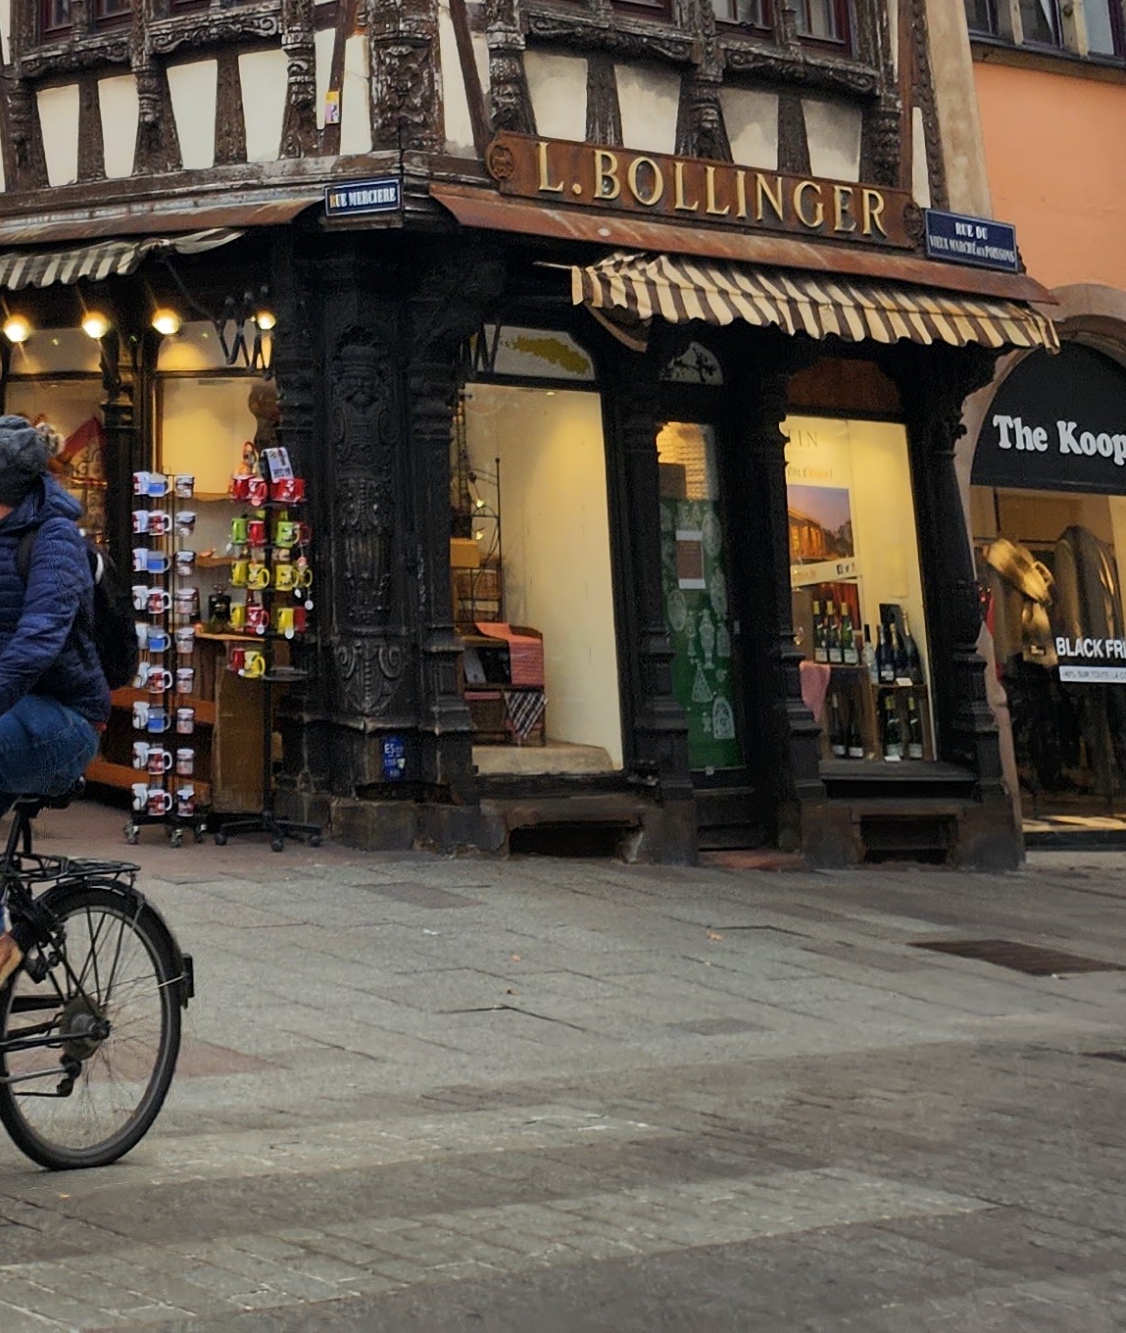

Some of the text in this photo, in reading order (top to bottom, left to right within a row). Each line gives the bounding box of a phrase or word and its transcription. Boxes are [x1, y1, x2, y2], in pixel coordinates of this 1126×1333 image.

[329, 187, 397, 209] RUE MERCIERE
[955, 221, 988, 240] RUE DU
[929, 235, 950, 250] VIEUX
[949, 239, 976, 256] MARCHÉ
[985, 245, 1015, 263] POISSONS
[992, 414, 1126, 466] The Koop
[1055, 636, 1104, 658] BLACK
